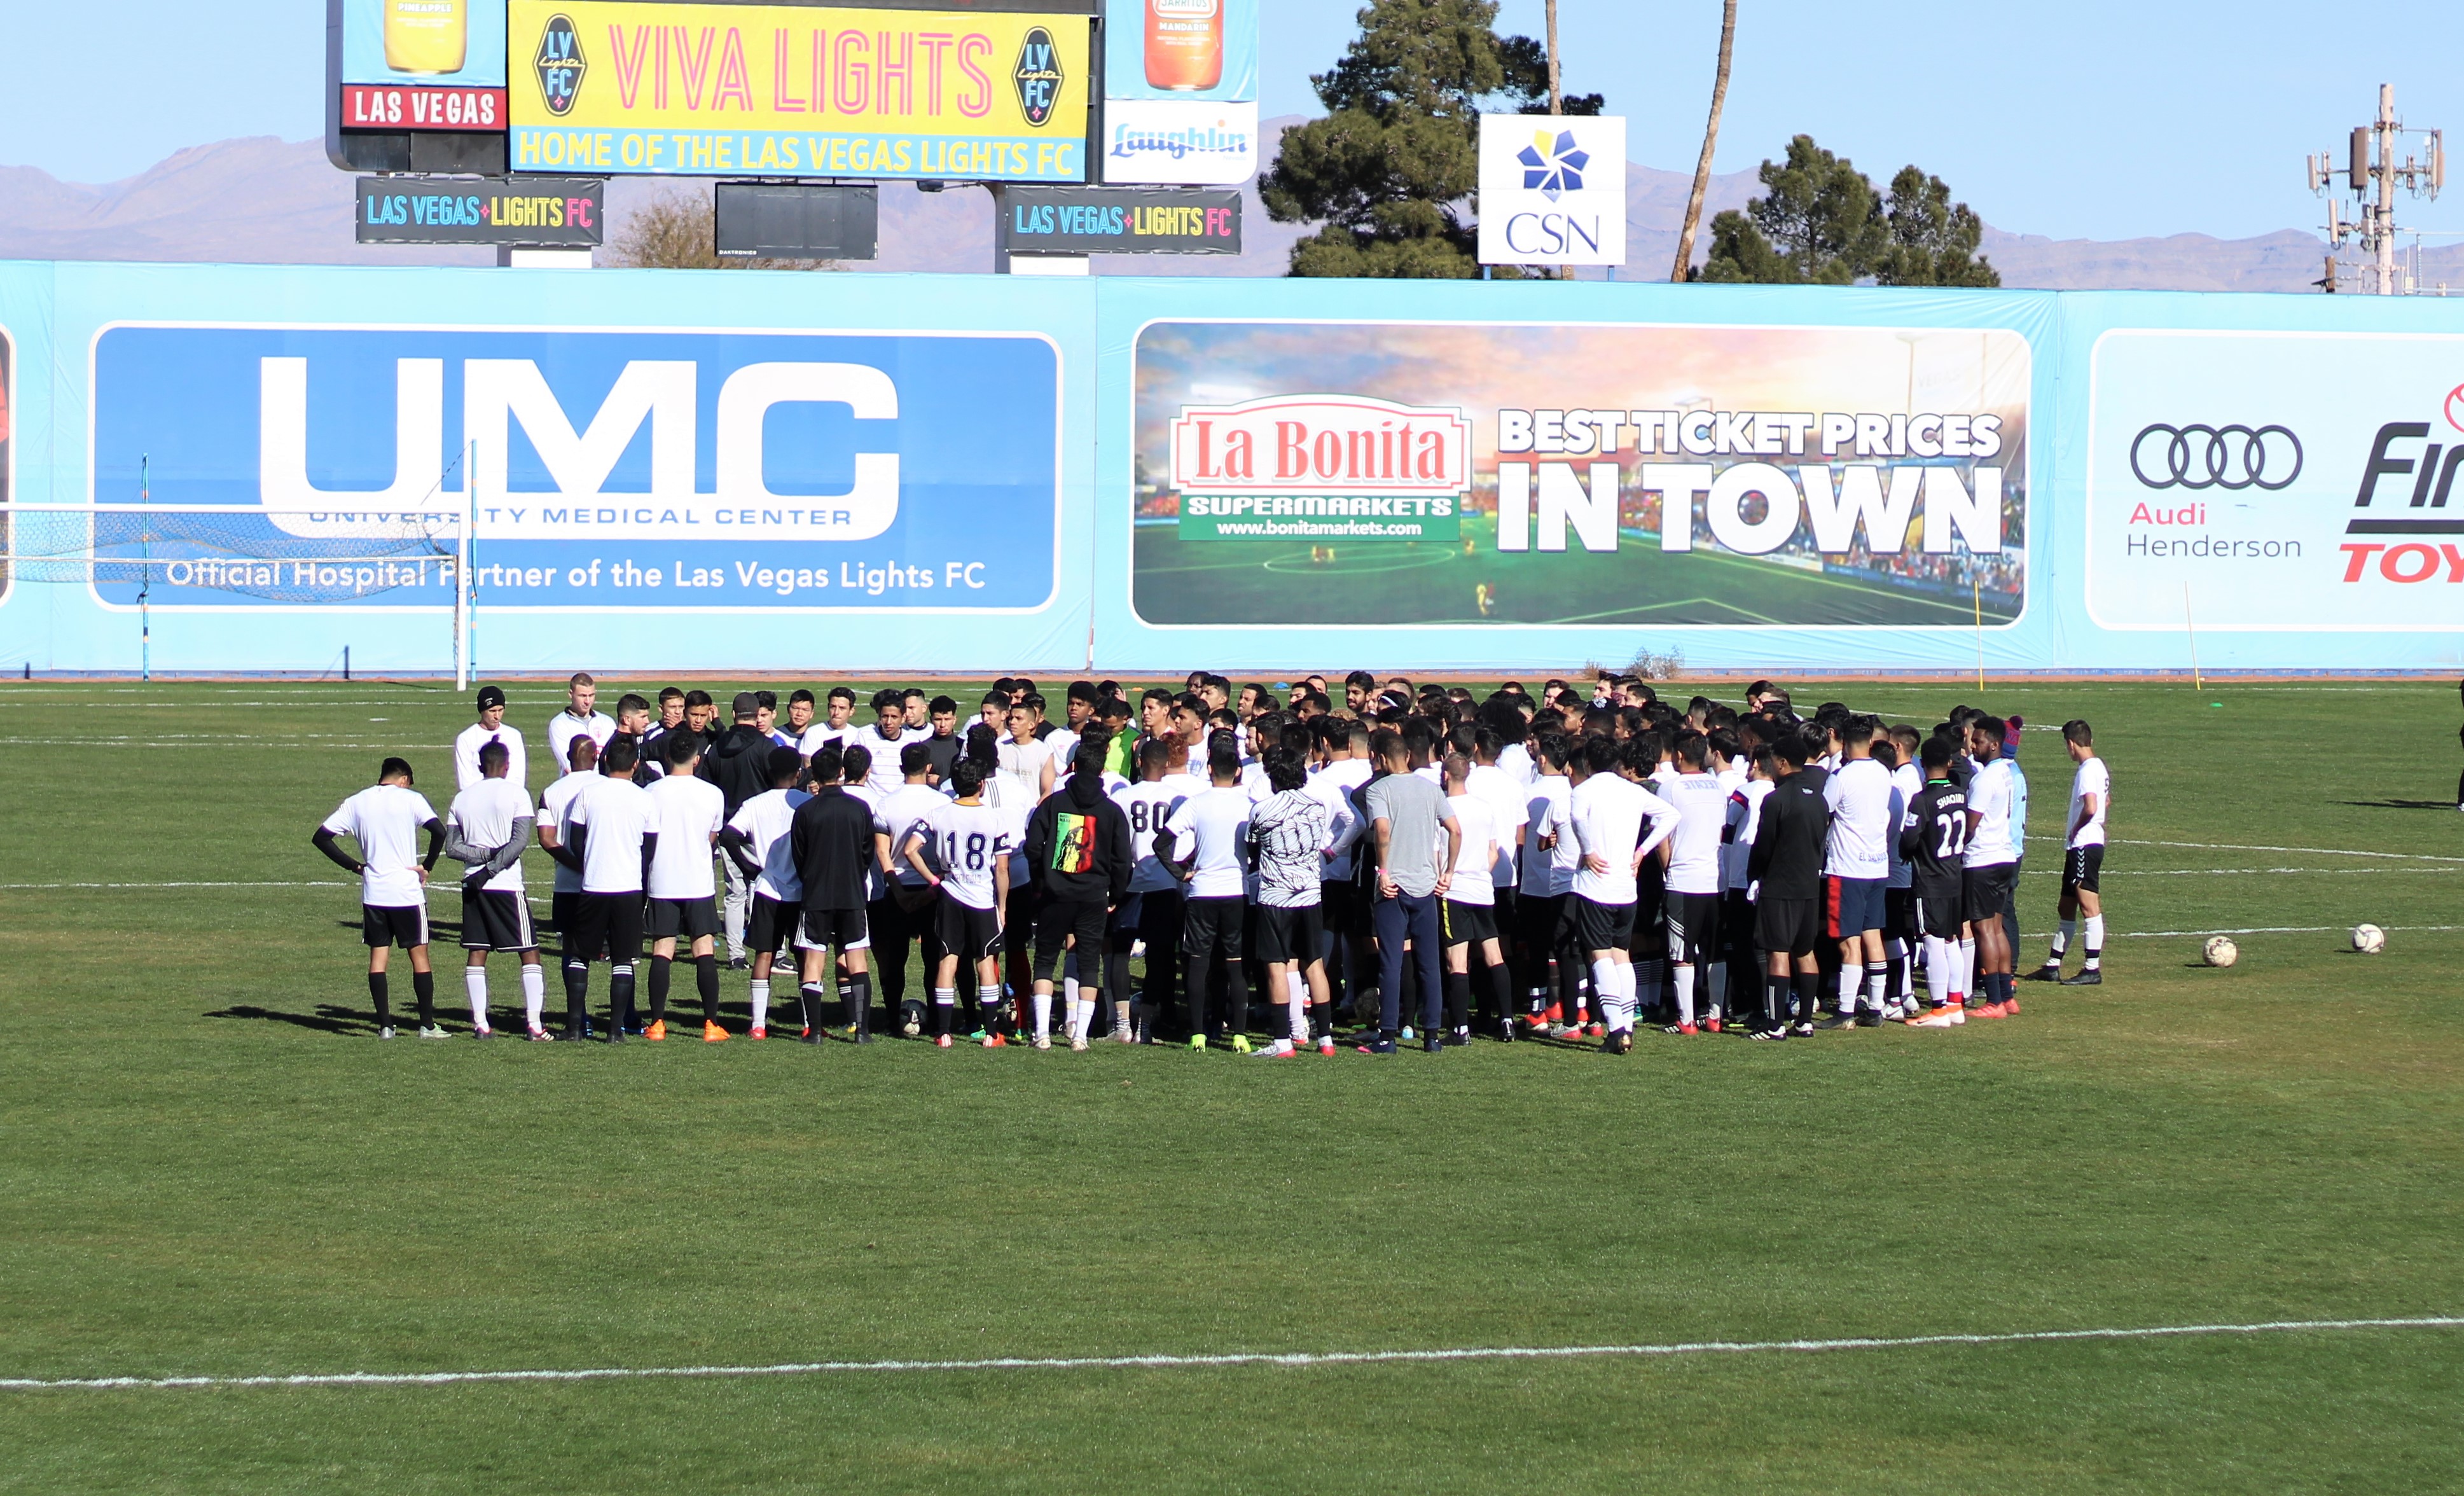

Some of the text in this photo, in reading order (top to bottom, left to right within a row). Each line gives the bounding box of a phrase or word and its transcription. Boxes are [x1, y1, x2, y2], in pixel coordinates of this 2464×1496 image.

[398, 3, 453, 13] PINEAPPLE
[1159, 22, 1210, 31] MANDARIN
[548, 31, 572, 59] LV
[1027, 43, 1051, 71] LV
[547, 68, 572, 96] FC
[609, 24, 993, 119] VIVA LIGHTS
[355, 92, 495, 125] LAS VEGAS
[1025, 80, 1049, 107] FC
[519, 132, 1073, 174] HOME OF THE LAS VEGAS LIGHTS FC
[1110, 119, 1248, 160] Laughlin
[367, 194, 593, 227] LAS VEGAS LIGHTS FC
[1016, 205, 1231, 237] LAS VEGAS LIGHTS FC
[1505, 212, 1599, 254] CSN
[261, 357, 899, 541] UMC
[1194, 420, 1446, 480] La Bonita
[1497, 409, 2003, 458] BEST TICKET PRICES
[309, 508, 851, 525] UNIVERTY MEDICAL CENTER
[1187, 497, 1453, 516] SUPERMARKETS
[1497, 462, 2004, 555] IN TOWN
[2128, 502, 2206, 525] Audi
[1216, 518, 1422, 537] www.bonitamarkets.com
[2127, 534, 2301, 558] Henderson
[167, 557, 280, 586] Official
[294, 560, 426, 593] Hospital
[568, 558, 600, 587] of
[613, 559, 663, 587] the
[675, 560, 724, 588] Las
[735, 561, 829, 595] Vegas
[840, 560, 934, 596] Lights
[945, 562, 986, 589] FC
[1130, 800, 1171, 835] 80
[1937, 810, 1967, 858] 22
[945, 830, 987, 871] 18
